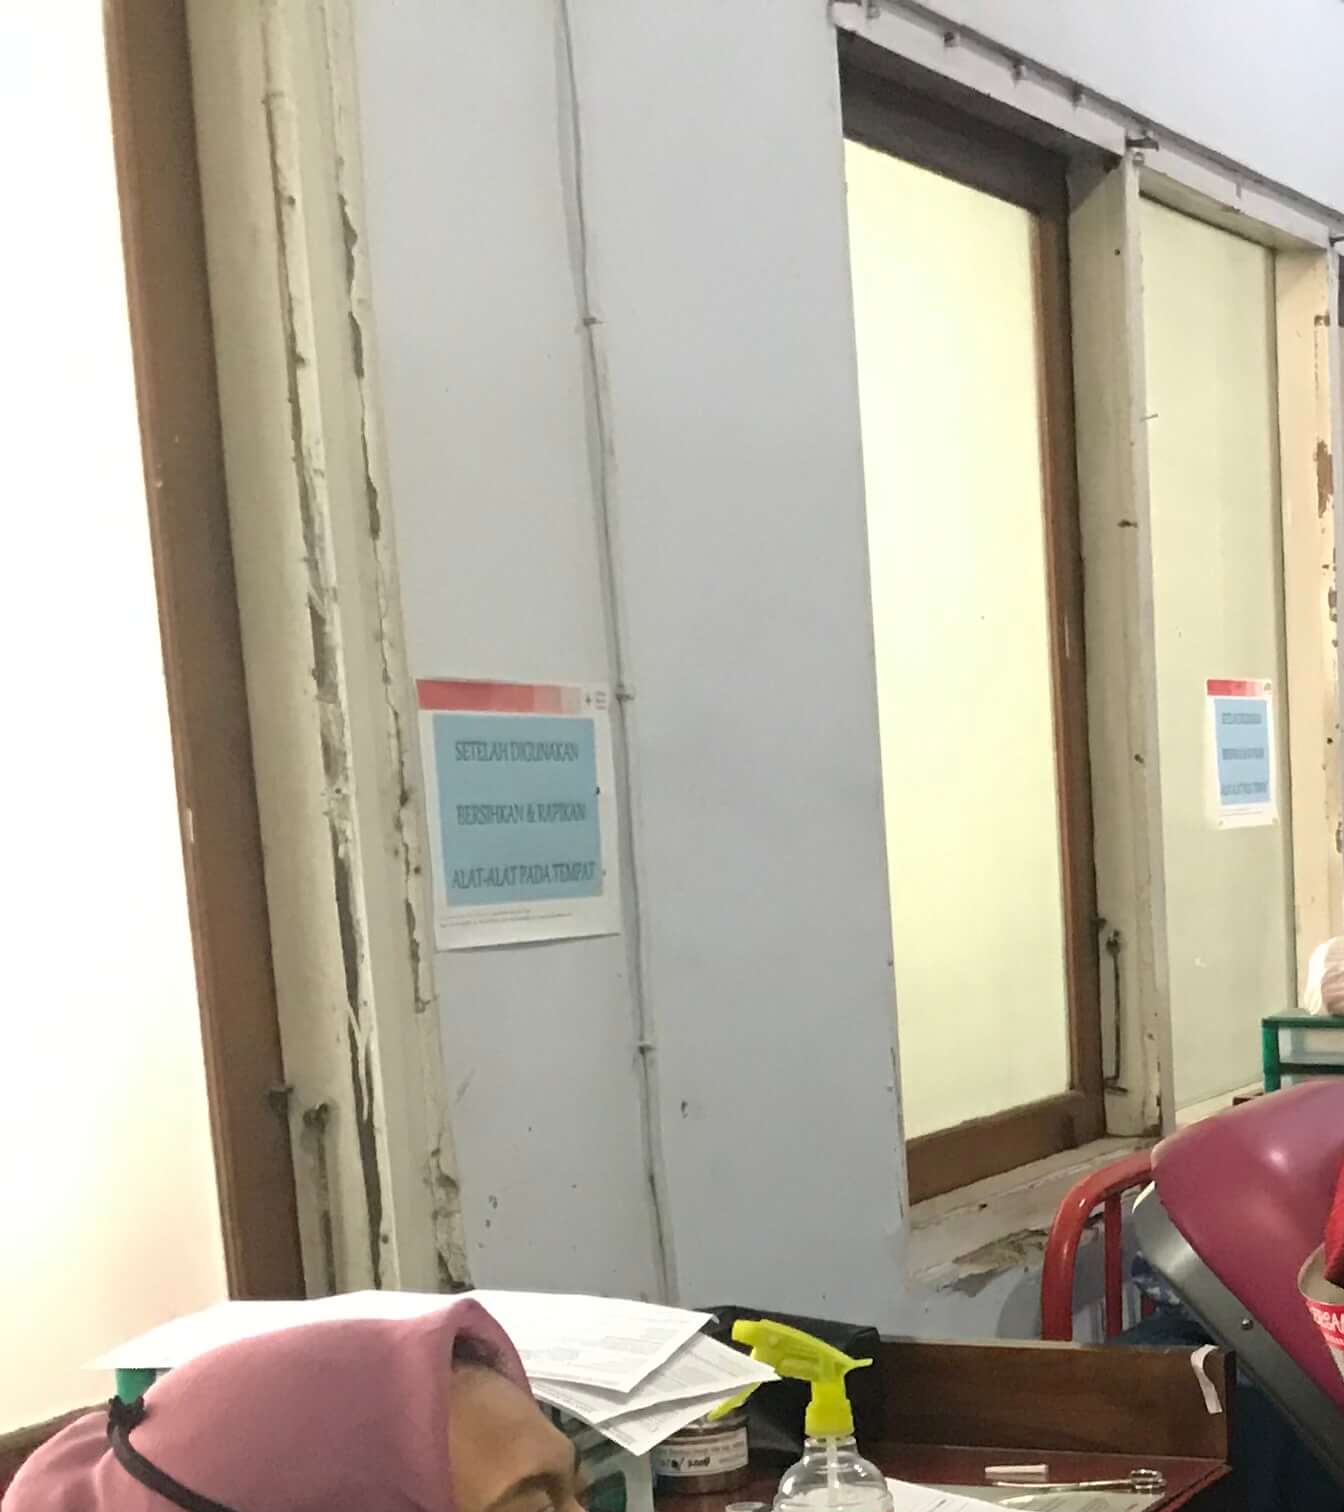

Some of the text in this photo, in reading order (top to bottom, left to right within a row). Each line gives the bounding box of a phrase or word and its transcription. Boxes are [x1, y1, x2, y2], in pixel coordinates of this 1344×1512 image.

[455, 740, 509, 763] SETELAH
[451, 860, 596, 889] ALAT-ALAT PADA TEMPAT
